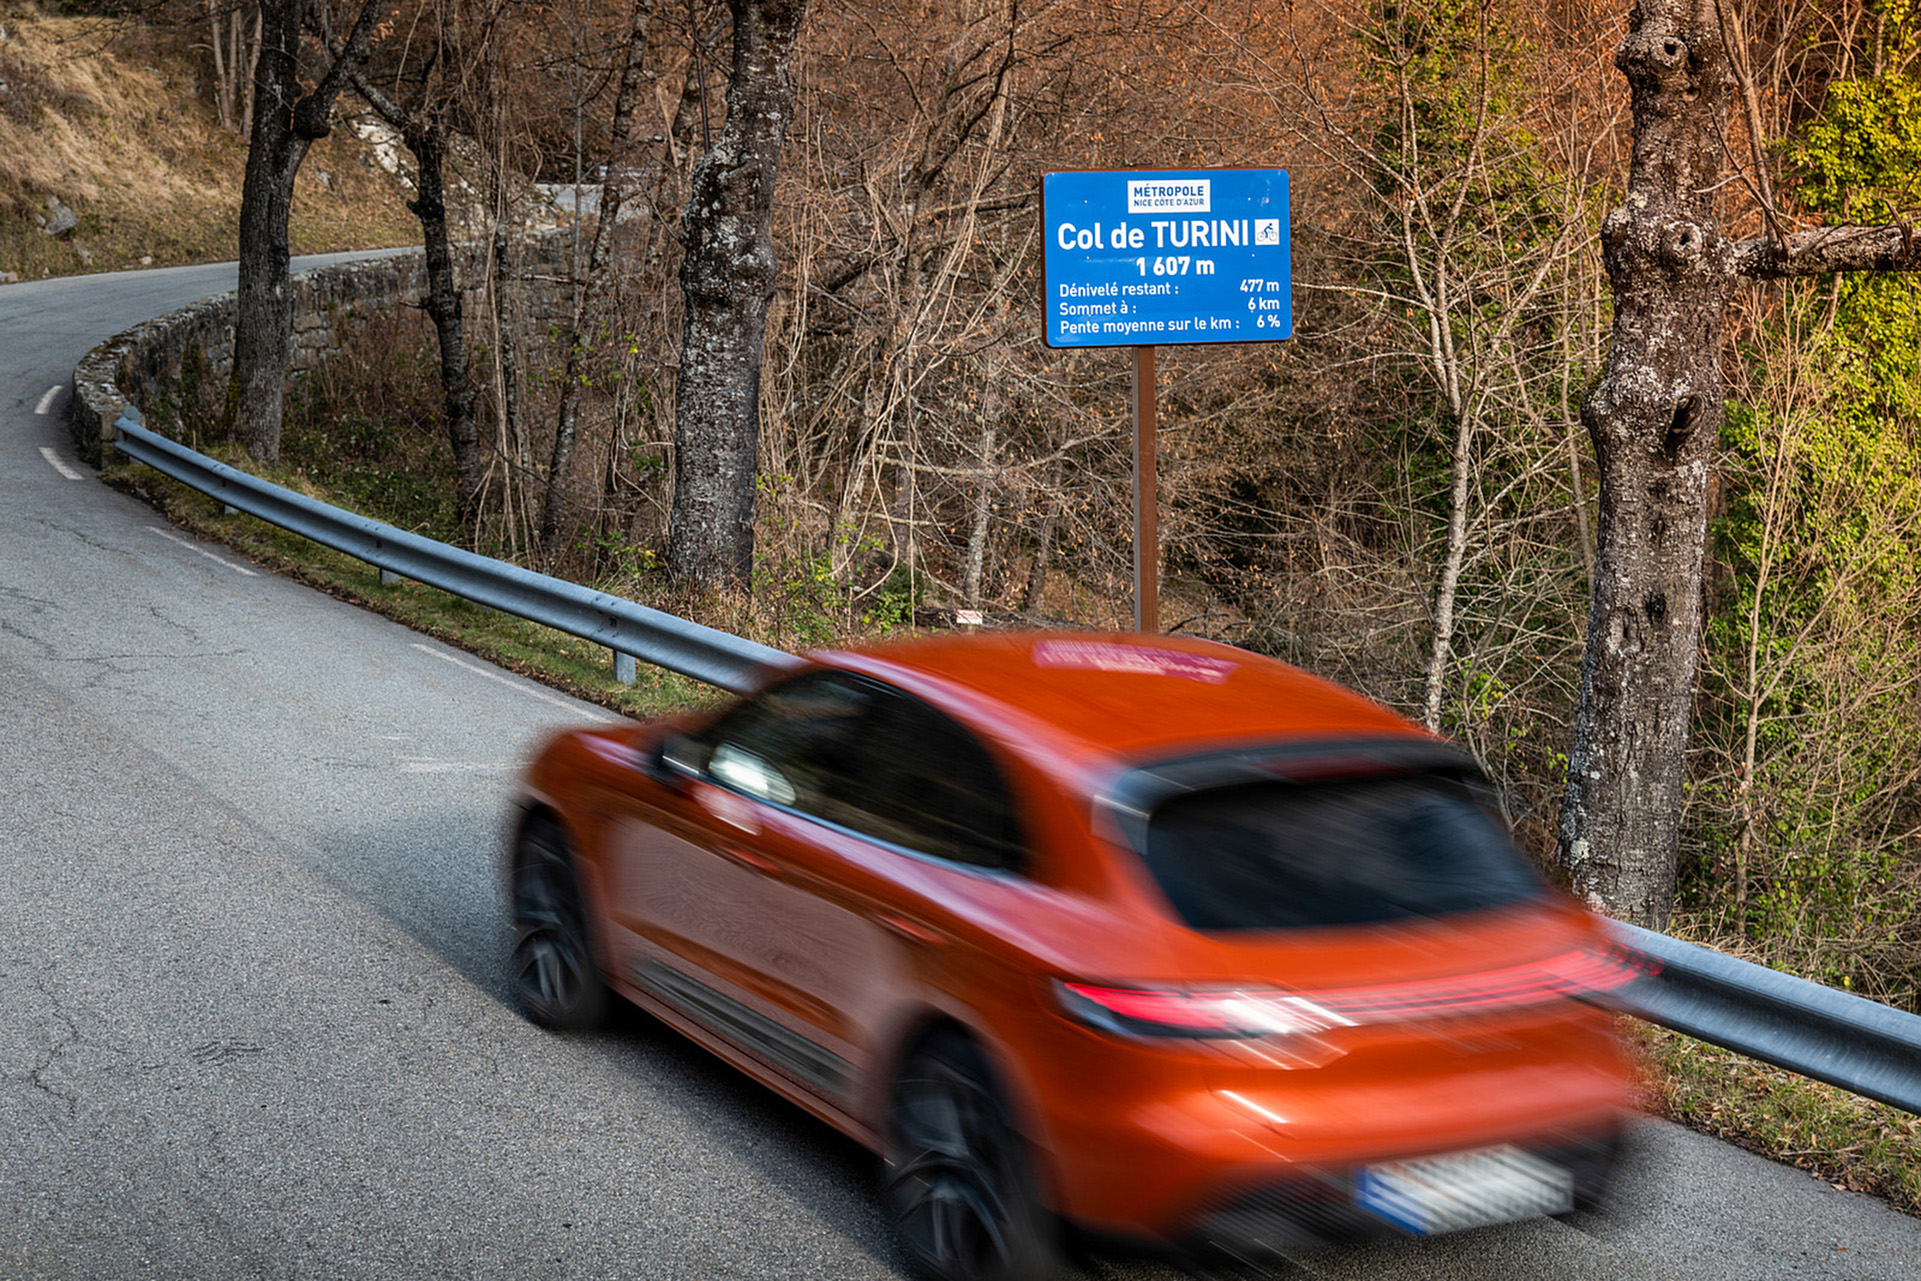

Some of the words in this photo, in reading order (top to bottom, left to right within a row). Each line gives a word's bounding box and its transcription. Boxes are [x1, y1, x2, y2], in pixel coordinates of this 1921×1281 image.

[1134, 184, 1204, 197] MÉTROPOLE
[1134, 199, 1152, 207] NICE
[1154, 197, 1175, 206] CÔTE
[1176, 198, 1204, 206] D'AZUR
[1058, 222, 1104, 250] Col
[1111, 221, 1144, 248] de
[1151, 220, 1248, 248] TURINI
[1136, 258, 1146, 276] 1
[1153, 257, 1190, 275] 607
[1196, 260, 1215, 275] m
[1060, 282, 1118, 297] Dénivelé
[1122, 283, 1171, 296] restant
[1240, 279, 1264, 292] 477
[1267, 282, 1279, 291] m
[1060, 302, 1117, 315] Sommet
[1120, 300, 1128, 314] à
[1248, 299, 1256, 311] 6
[1258, 297, 1279, 310] km
[1060, 321, 1099, 334] Pente
[1103, 322, 1164, 335] moyenne
[1168, 321, 1190, 331] sur
[1195, 318, 1206, 330] le
[1210, 317, 1232, 329] km
[1257, 316, 1265, 328] 6
[1267, 315, 1280, 328] %
